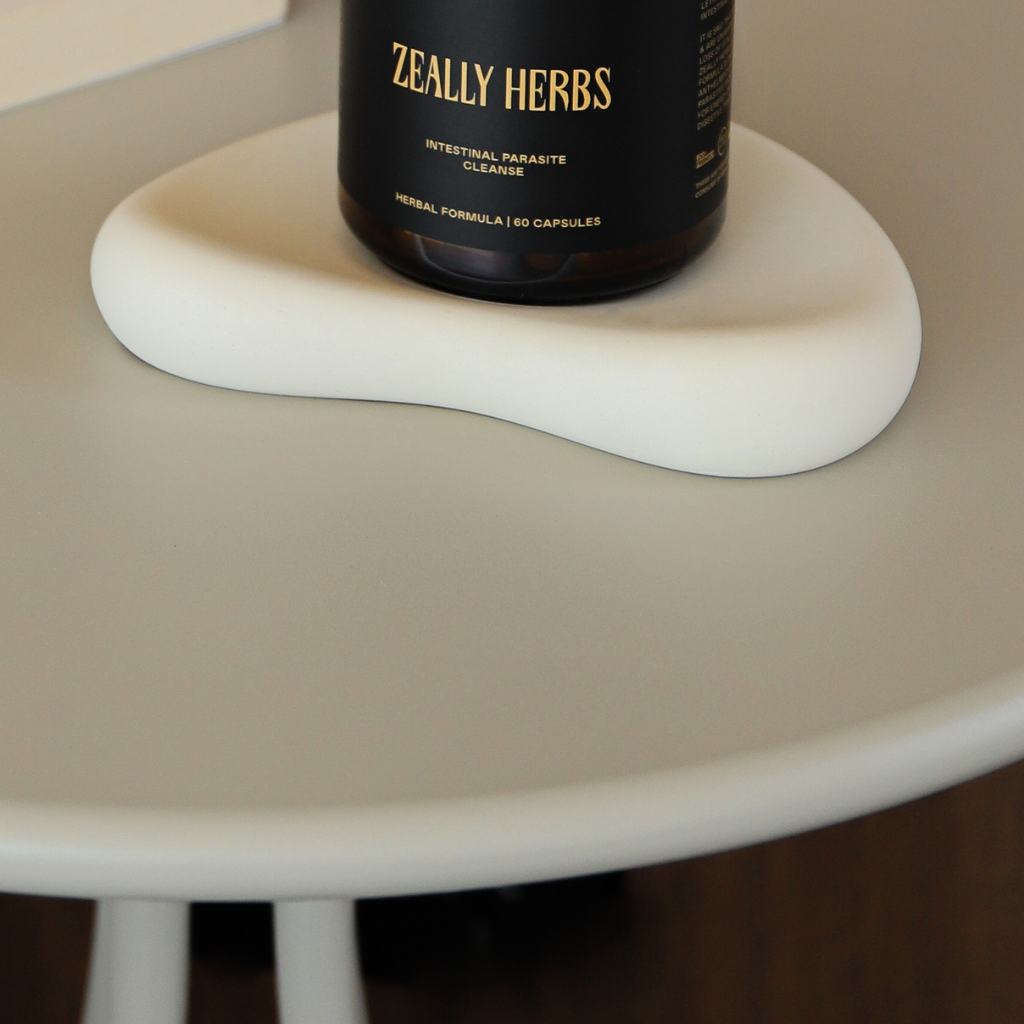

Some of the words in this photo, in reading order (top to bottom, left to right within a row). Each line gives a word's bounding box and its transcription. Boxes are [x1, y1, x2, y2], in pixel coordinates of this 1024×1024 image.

[392, 41, 495, 107] ZEALLY
[504, 67, 613, 112] HERBS
[425, 138, 499, 162] INTESTINAL
[502, 152, 567, 165] PARASITE
[462, 161, 525, 177] CLEANSE
[395, 191, 438, 215] HERBAL
[441, 206, 504, 226] FORMULA
[513, 218, 530, 228] 60
[533, 216, 602, 228] CAPSULES
